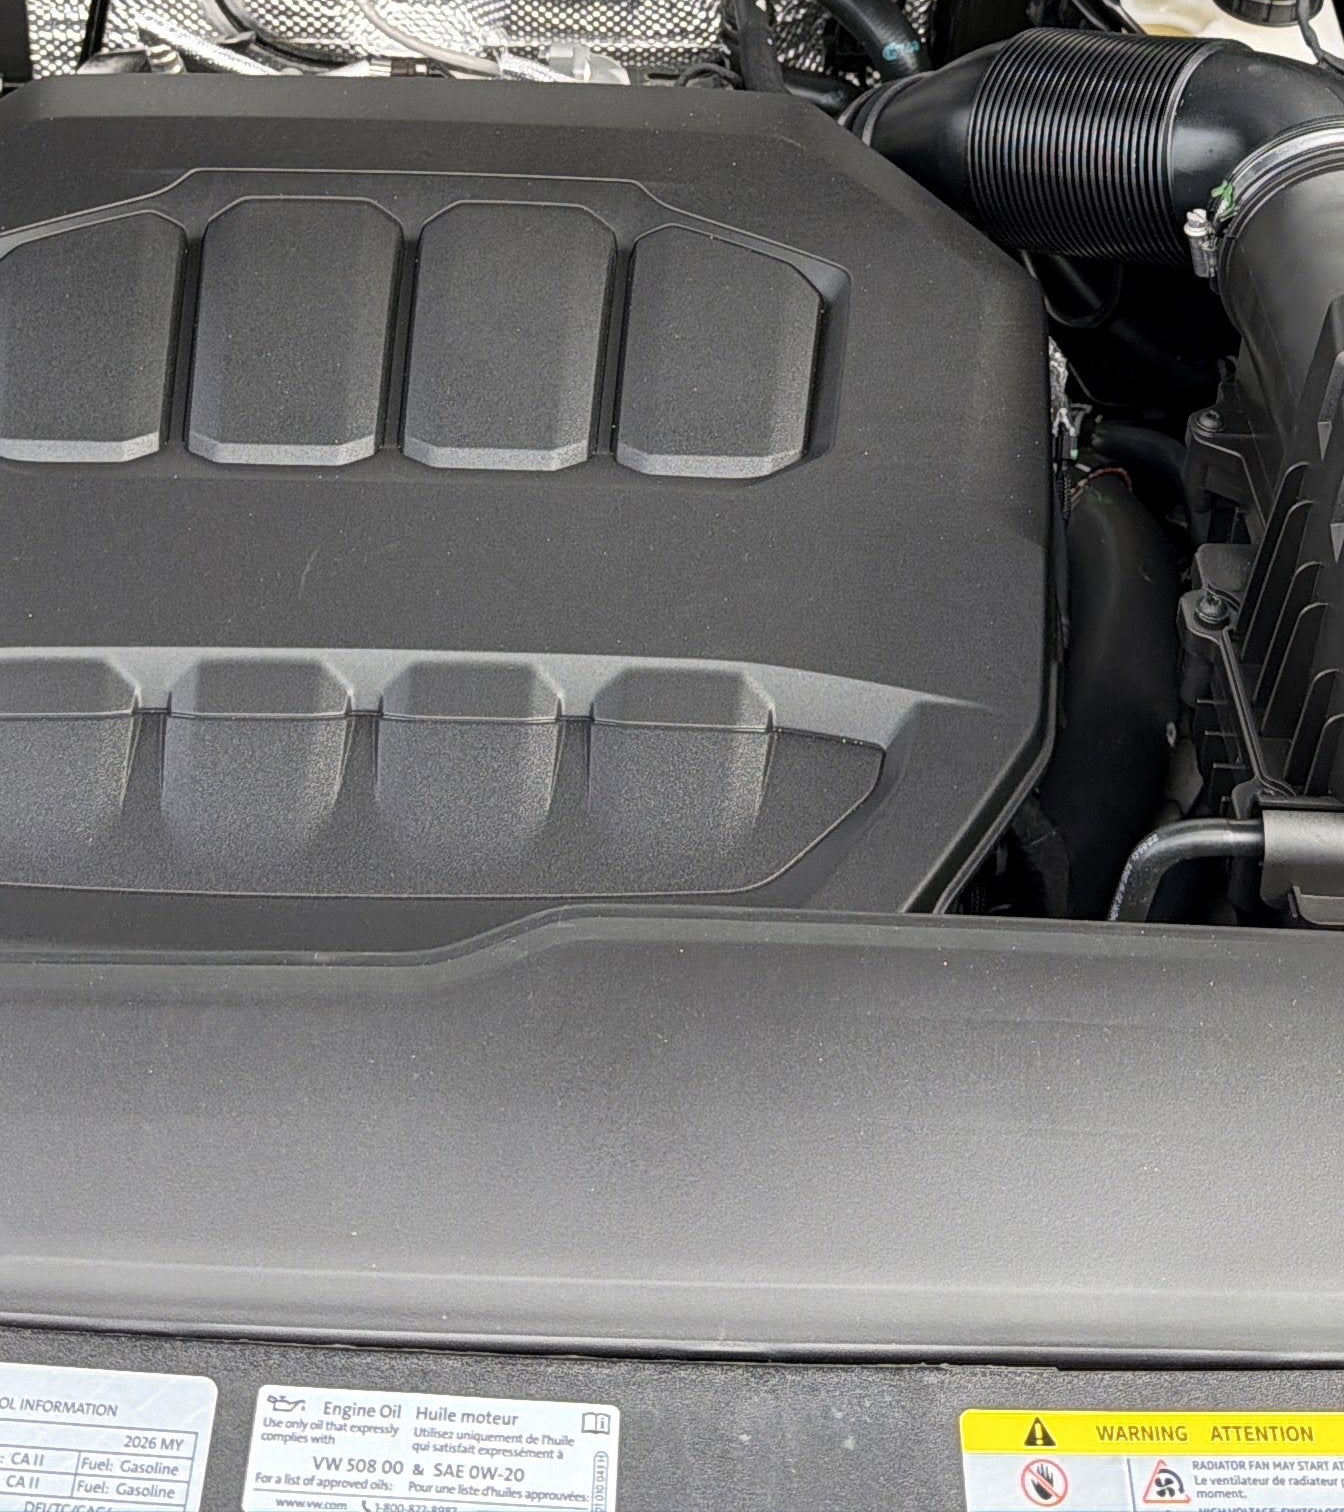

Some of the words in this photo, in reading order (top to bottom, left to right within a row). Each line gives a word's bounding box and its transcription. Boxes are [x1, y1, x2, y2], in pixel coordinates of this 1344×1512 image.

[19, 1398, 118, 1418] INFORMATION
[323, 1401, 377, 1420] Engine
[379, 1404, 402, 1419] Oil
[416, 1406, 456, 1423] Huile
[460, 1411, 519, 1427] moteur
[263, 1417, 282, 1430] Use
[284, 1418, 308, 1433] only
[309, 1419, 325, 1431] oil
[325, 1420, 348, 1433] that
[349, 1422, 400, 1438] expressly
[413, 1426, 454, 1441] Utilisez
[456, 1429, 523, 1447] uniquement
[525, 1432, 540, 1445] de
[1096, 1425, 1188, 1443] WARNING
[1210, 1425, 1314, 1443] ATTENTION
[123, 1435, 157, 1450] 2026
[160, 1438, 185, 1452] MY
[261, 1431, 308, 1448] complies
[310, 1433, 336, 1446] with
[412, 1440, 431, 1455] qui
[432, 1441, 476, 1456] satisfait
[477, 1443, 550, 1462] expressément
[81, 1456, 113, 1472] Fuel:
[119, 1459, 180, 1476] Gasoline
[312, 1455, 343, 1472] VW
[347, 1458, 378, 1474] 508
[381, 1460, 404, 1475] 00
[412, 1462, 425, 1476] &
[433, 1462, 465, 1479] SAE
[468, 1465, 525, 1483] 0W-20
[1192, 1460, 1246, 1472] RADIATOR
[1247, 1460, 1270, 1472] FAN
[1272, 1460, 1296, 1473] MAY
[1297, 1461, 1330, 1473] START
[77, 1479, 109, 1495] Fuel:
[115, 1482, 176, 1500] Gasoline
[255, 1472, 273, 1485] For
[283, 1473, 301, 1487] list
[302, 1475, 315, 1488] of
[316, 1477, 369, 1491] approved
[369, 1479, 393, 1492] oils:
[408, 1481, 434, 1495] Pour
[435, 1484, 457, 1495] une
[457, 1483, 482, 1497] liste
[1194, 1475, 1206, 1487] Le
[1208, 1475, 1271, 1488] ventilateur
[1273, 1475, 1285, 1487] de
[1287, 1475, 1338, 1488] radiateur
[276, 1497, 348, 1511] www.vw.com
[1196, 1489, 1247, 1501] moment.
